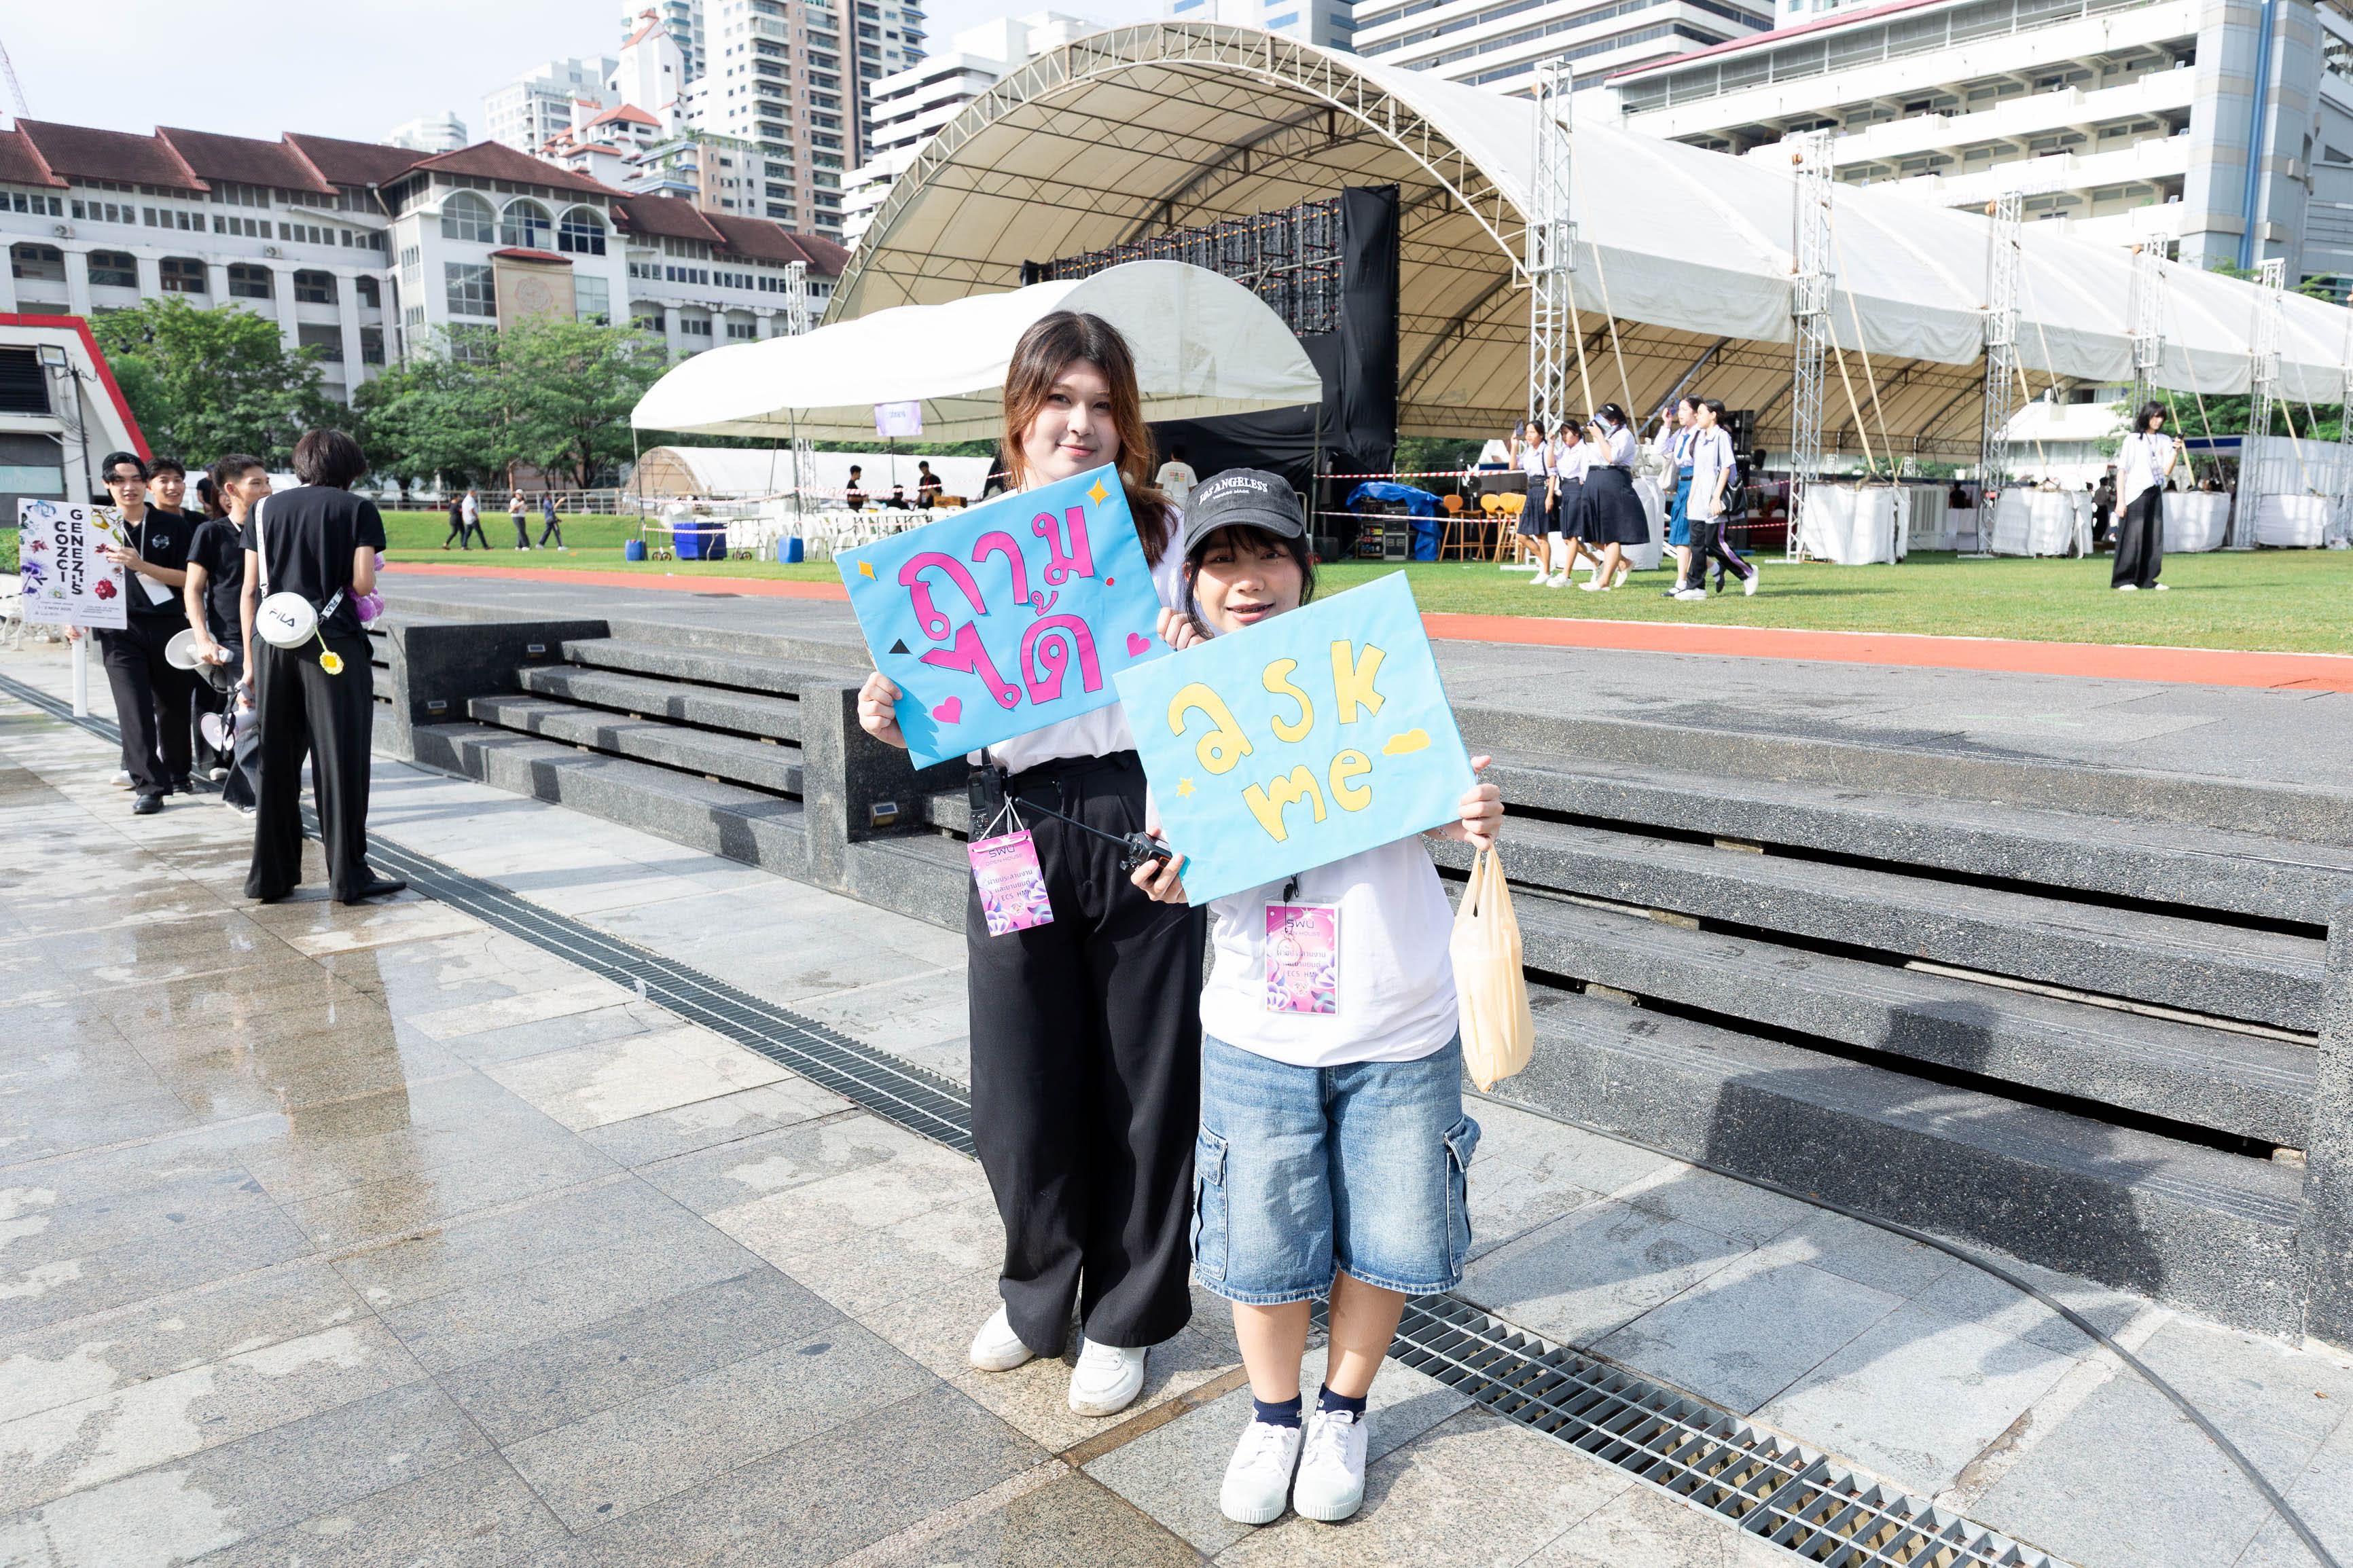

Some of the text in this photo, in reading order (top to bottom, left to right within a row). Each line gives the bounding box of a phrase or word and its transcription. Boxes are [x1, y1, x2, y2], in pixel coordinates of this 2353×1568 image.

[54, 521, 69, 582] COZCI
[899, 505, 1094, 640] ถาม
[269, 608, 295, 627] FILA
[918, 591, 1102, 709] ได้
[1168, 639, 1386, 776] ask
[1241, 748, 1372, 843] me
[989, 845, 1015, 858] SWU
[1003, 854, 1022, 862] HOUSE
[1287, 919, 1314, 928] SWU
